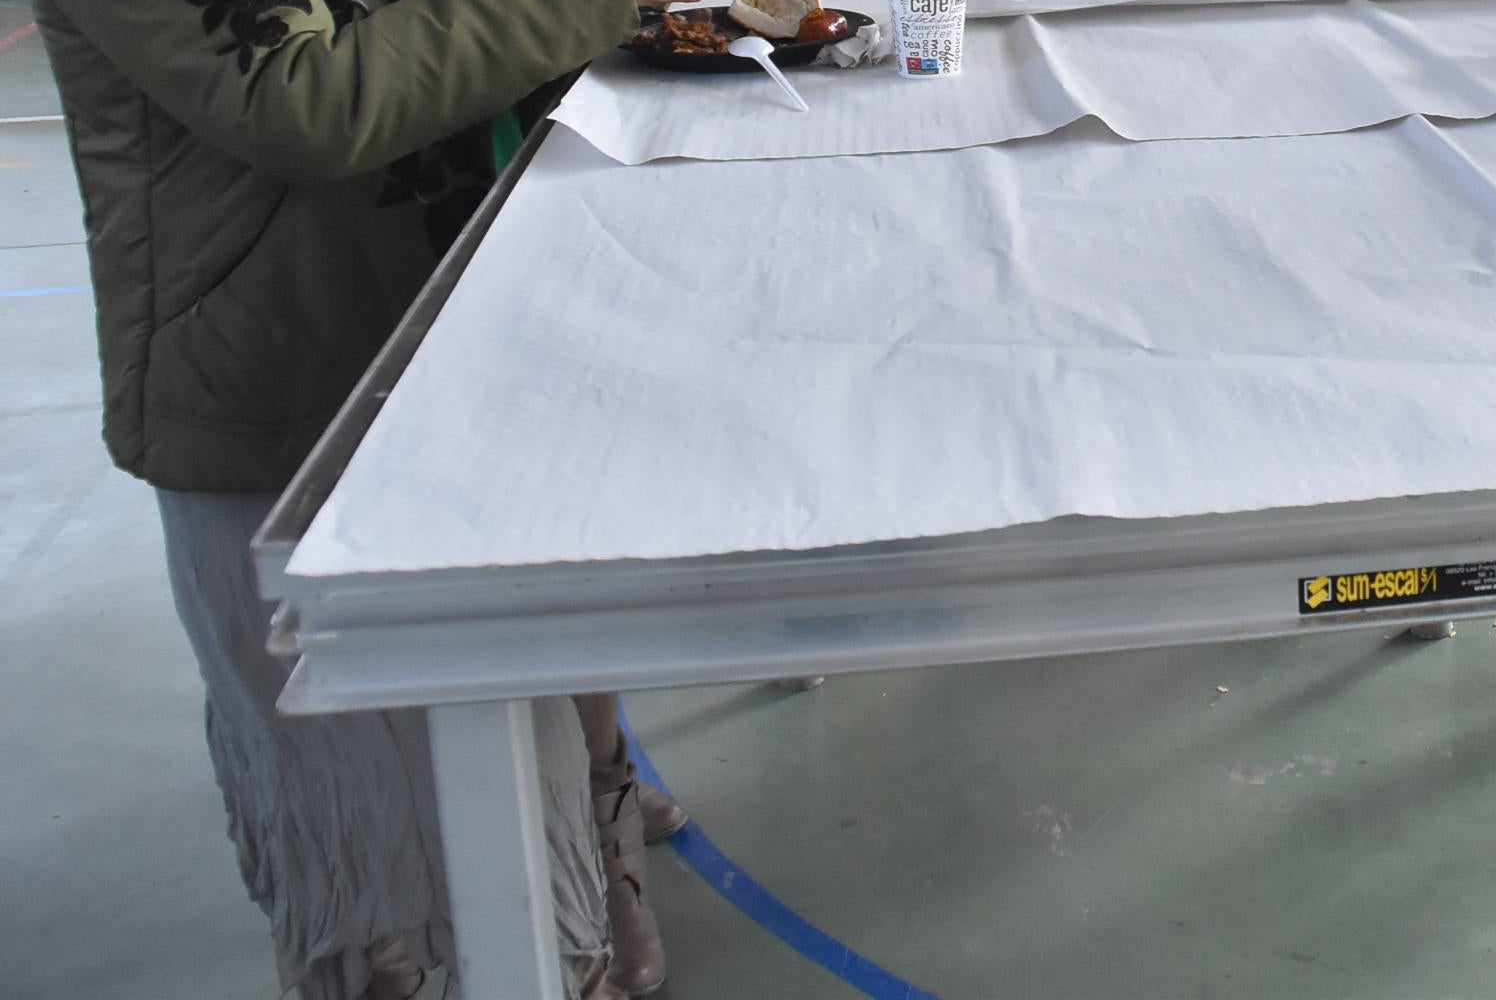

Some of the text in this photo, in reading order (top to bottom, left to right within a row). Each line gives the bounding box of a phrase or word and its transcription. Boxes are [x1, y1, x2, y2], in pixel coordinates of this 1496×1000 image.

[904, 40, 920, 49] tea
[939, 40, 955, 73] coffee
[1336, 567, 1419, 603] sum-escal
